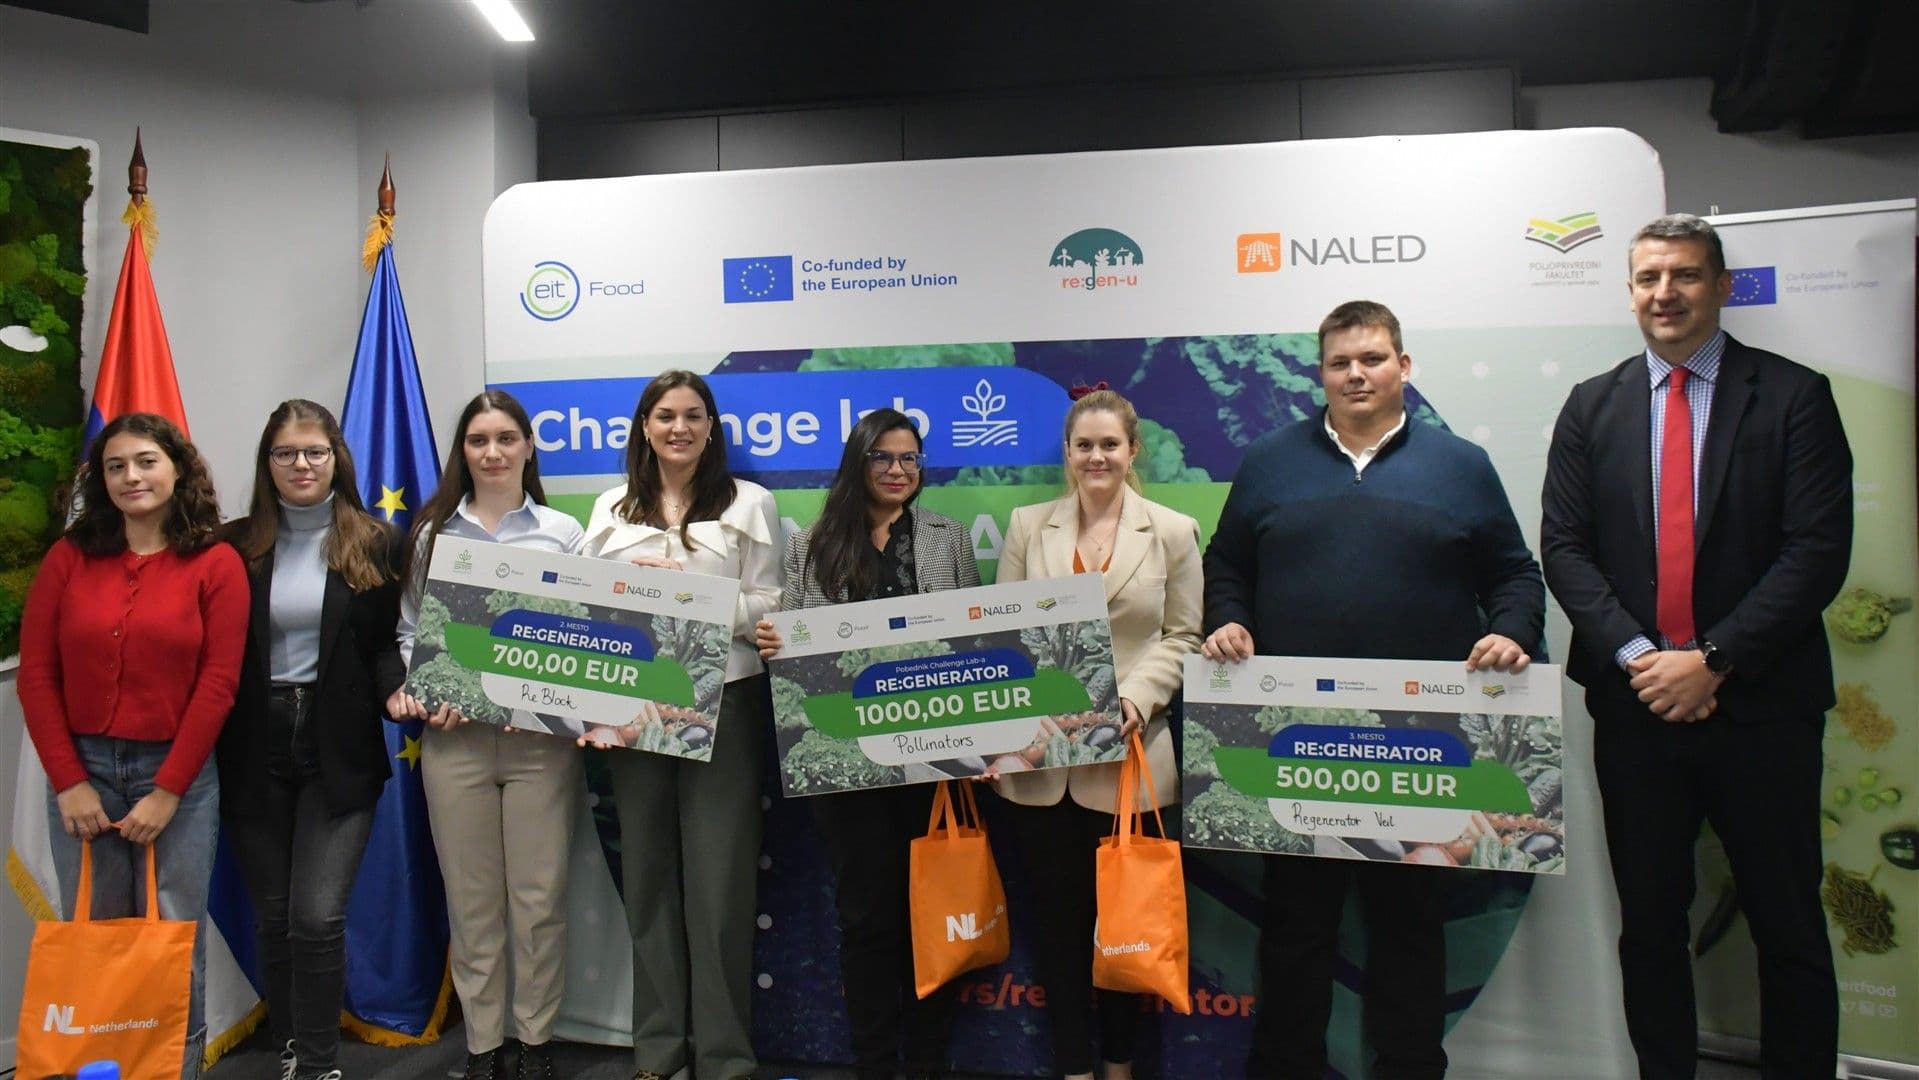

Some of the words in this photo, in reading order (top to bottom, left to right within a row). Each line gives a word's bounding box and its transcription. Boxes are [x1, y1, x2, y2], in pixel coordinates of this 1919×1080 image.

[1291, 234, 1426, 266] NALED
[802, 257, 883, 272] Co-funded
[888, 257, 906, 271] by
[534, 280, 566, 299] eit
[589, 280, 645, 297] Food
[802, 279, 826, 291] the
[832, 277, 906, 291] European
[912, 274, 958, 287] Union
[1062, 275, 1138, 290] re:gen-u
[531, 407, 820, 457] Change
[839, 397, 931, 443] lb
[627, 585, 662, 599] NALED
[983, 603, 1021, 616] NALED
[566, 622, 590, 632] MESTO
[511, 624, 633, 655] RE:GENERATOR
[493, 643, 578, 676] 700,00
[585, 659, 639, 687] EUR
[895, 663, 929, 674] Pobednik
[930, 660, 966, 671] Challenge
[966, 657, 986, 666] Lab-a
[875, 665, 1009, 693] RE:GENERATOR
[1421, 684, 1465, 695] NALED
[541, 687, 578, 710] Block
[855, 694, 965, 726] 1000,00
[973, 686, 1032, 713] EUR
[893, 734, 974, 755] Pollinators
[1357, 733, 1386, 741] MESTO
[1294, 741, 1443, 763] RE:GENERATOR
[1276, 765, 1381, 795] 500,00
[1391, 771, 1457, 797] EUR
[1291, 802, 1361, 830] Regenerator
[946, 912, 983, 942] NL
[43, 1003, 85, 1034] NL
[89, 1018, 160, 1033] Netherlands
